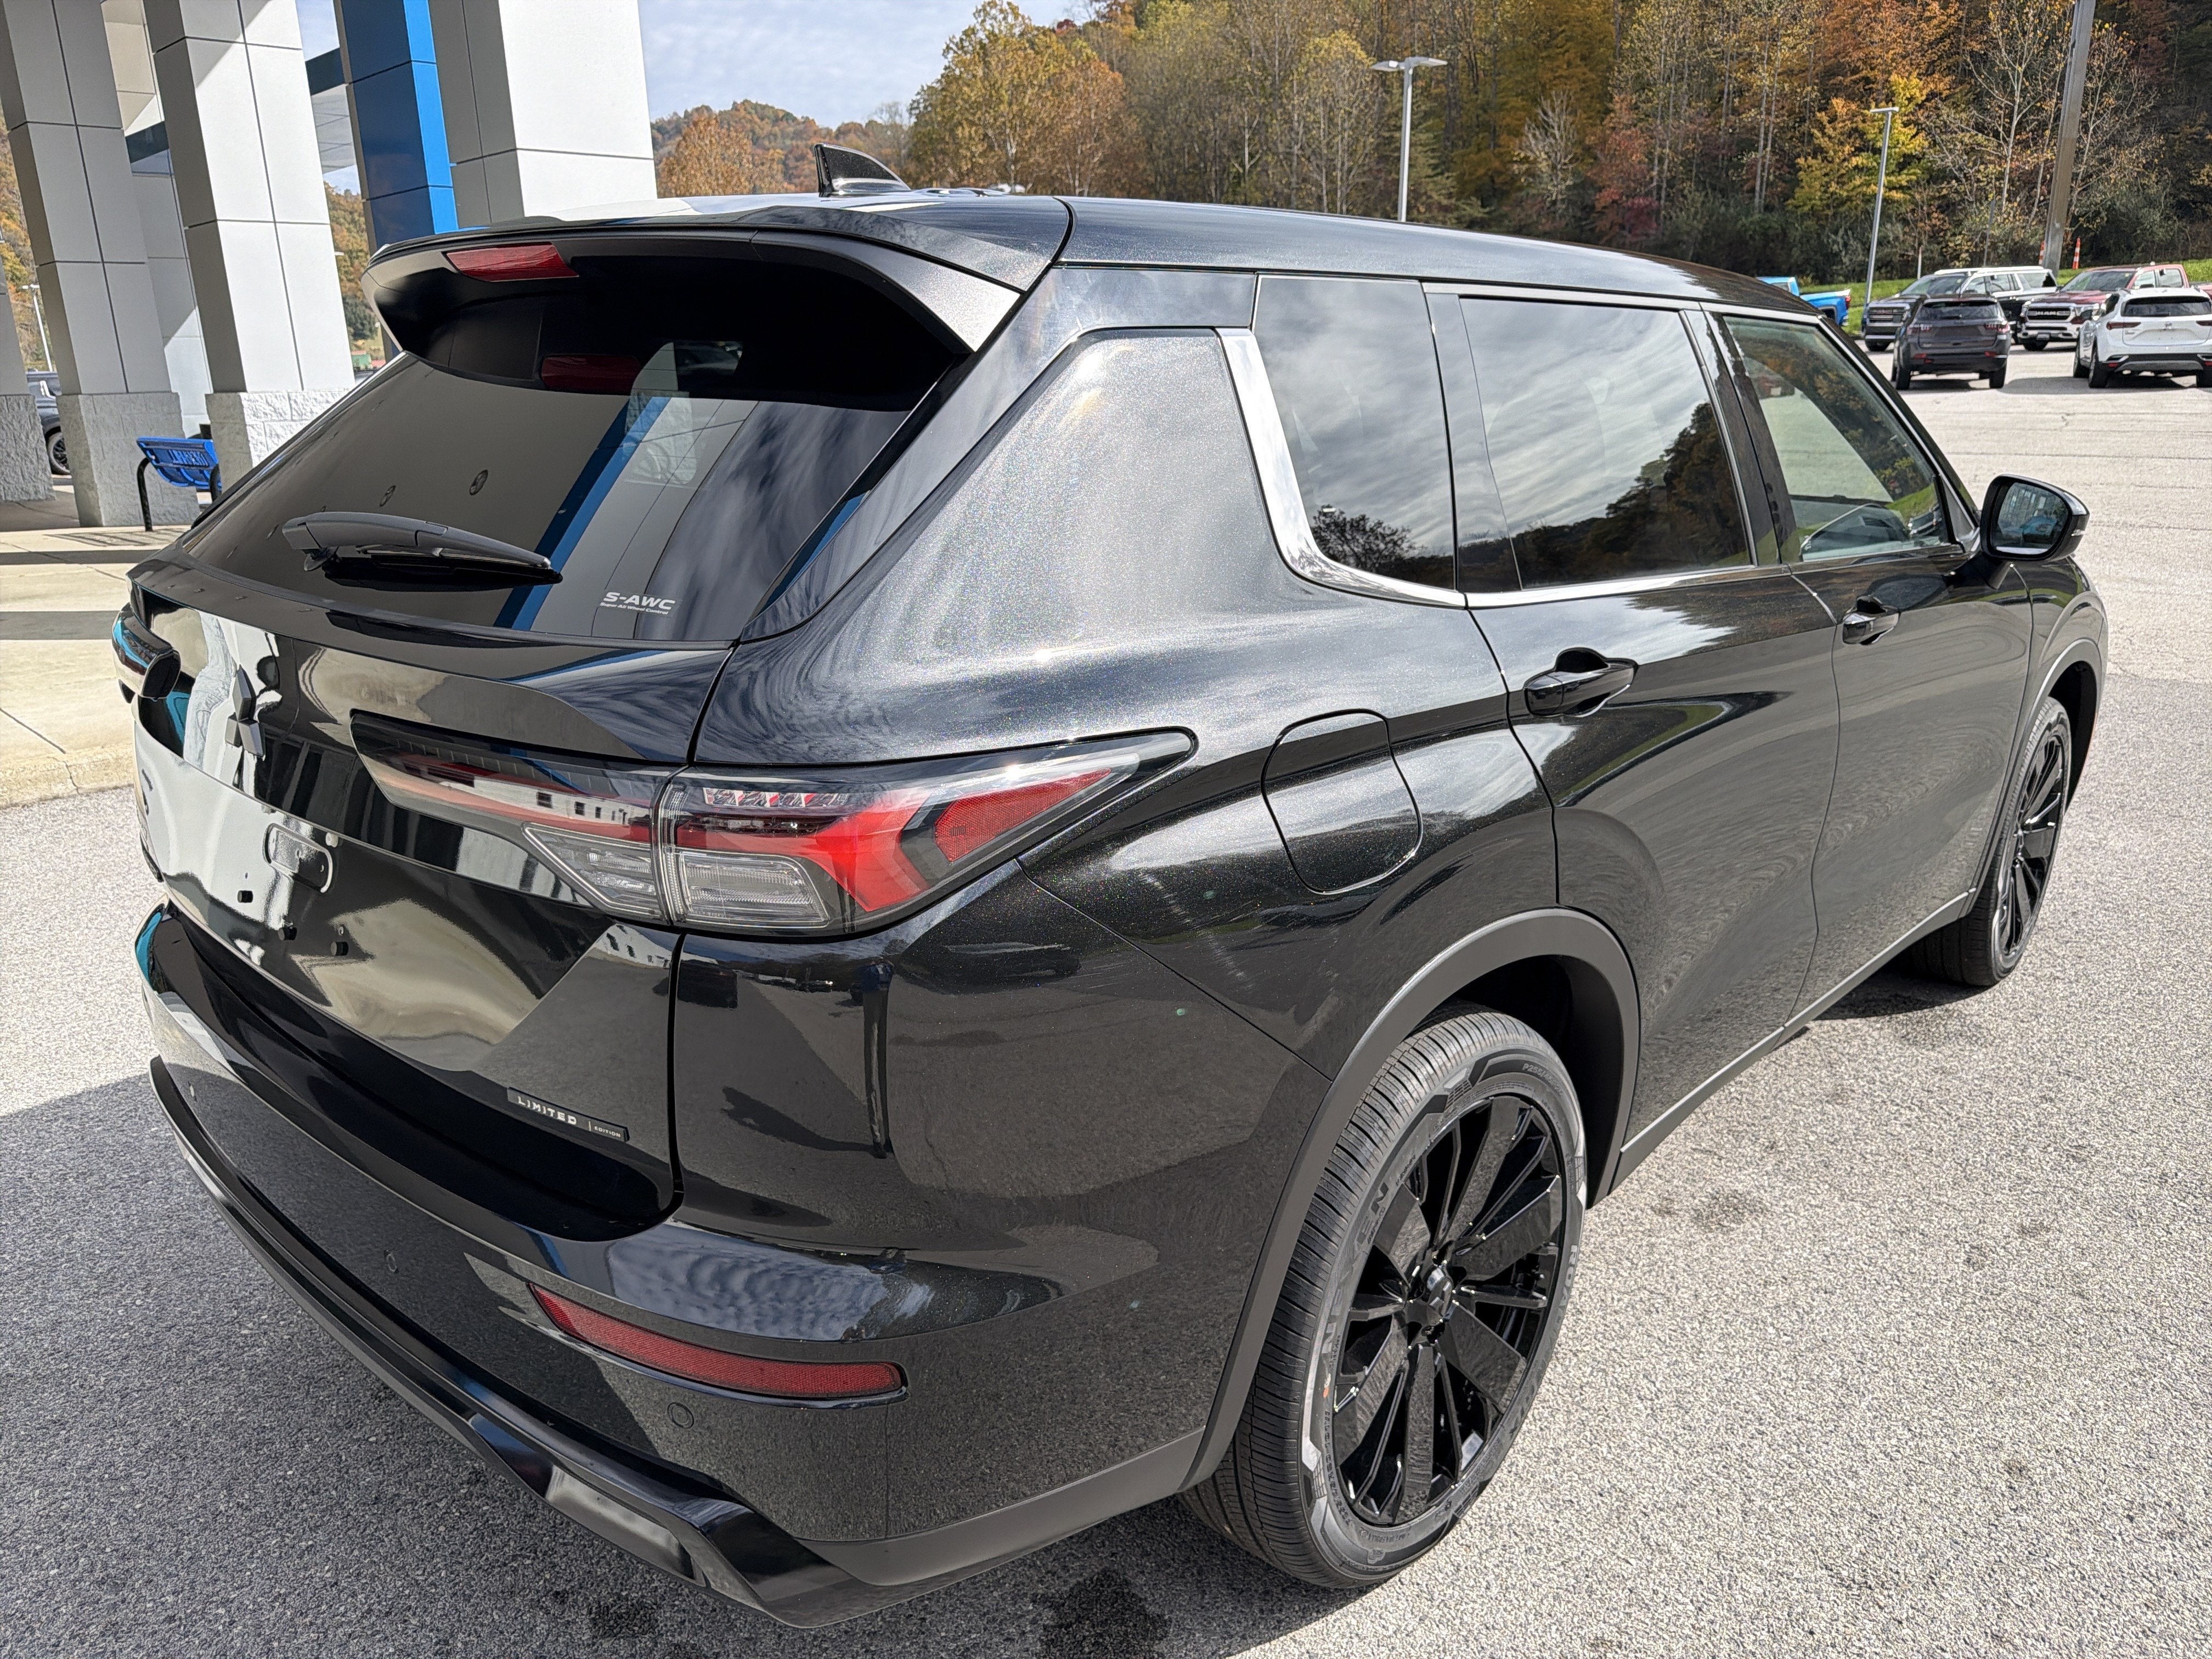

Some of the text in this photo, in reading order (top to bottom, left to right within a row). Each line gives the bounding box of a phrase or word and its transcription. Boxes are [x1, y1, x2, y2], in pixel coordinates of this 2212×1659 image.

[603, 592, 676, 610] S-AWC
[517, 1096, 621, 1138] LIMITED EDITION
